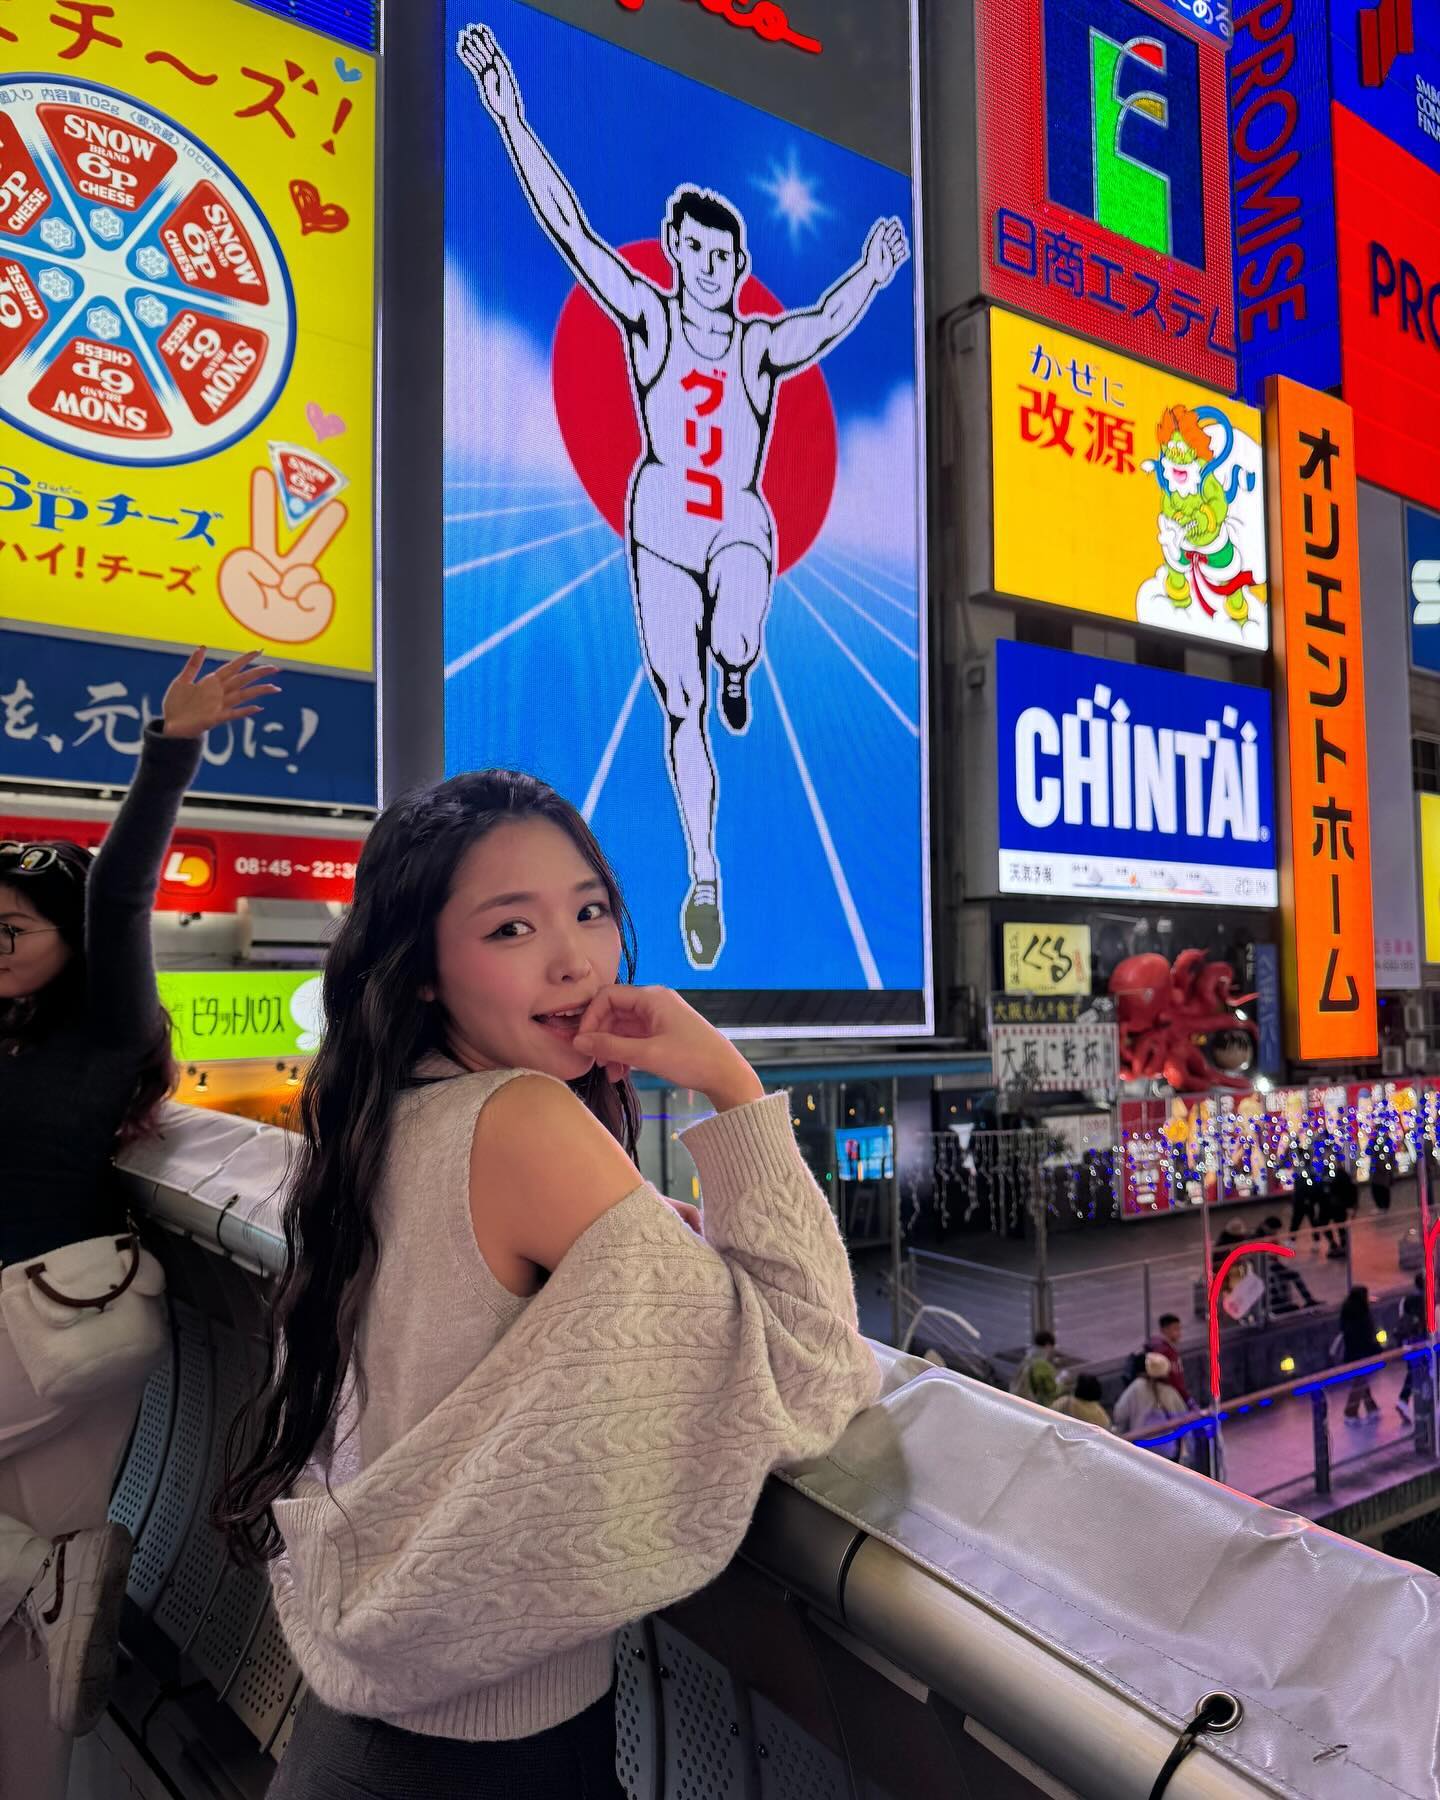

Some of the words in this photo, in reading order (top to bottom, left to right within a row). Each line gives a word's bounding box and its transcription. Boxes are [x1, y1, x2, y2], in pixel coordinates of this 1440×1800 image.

[63, 113, 157, 162] SNOW
[89, 144, 131, 165] BRAND
[76, 152, 138, 191] 6P
[78, 179, 136, 208] CHEESE
[1230, 0, 1306, 342] PROMISE
[8, 187, 48, 231] CHEESE
[164, 229, 199, 282] CHEESE
[182, 222, 217, 279] 6P
[202, 203, 262, 286] SNOW
[5, 264, 44, 320] CHEESE
[75, 341, 132, 367] CHEESE
[161, 313, 197, 356] CHEESE
[177, 328, 221, 371] 6P
[72, 358, 135, 395] 6P
[200, 339, 257, 414] SNOW
[1029, 343, 1125, 408] かぜに
[51, 390, 148, 432] SNOW
[1018, 385, 1137, 474] 改源
[680, 368, 727, 522] グリコ
[0, 678, 319, 774] を、元に!
[1298, 426, 1361, 1013] オリエントホーム
[191, 995, 286, 1037] ピタットハウス
